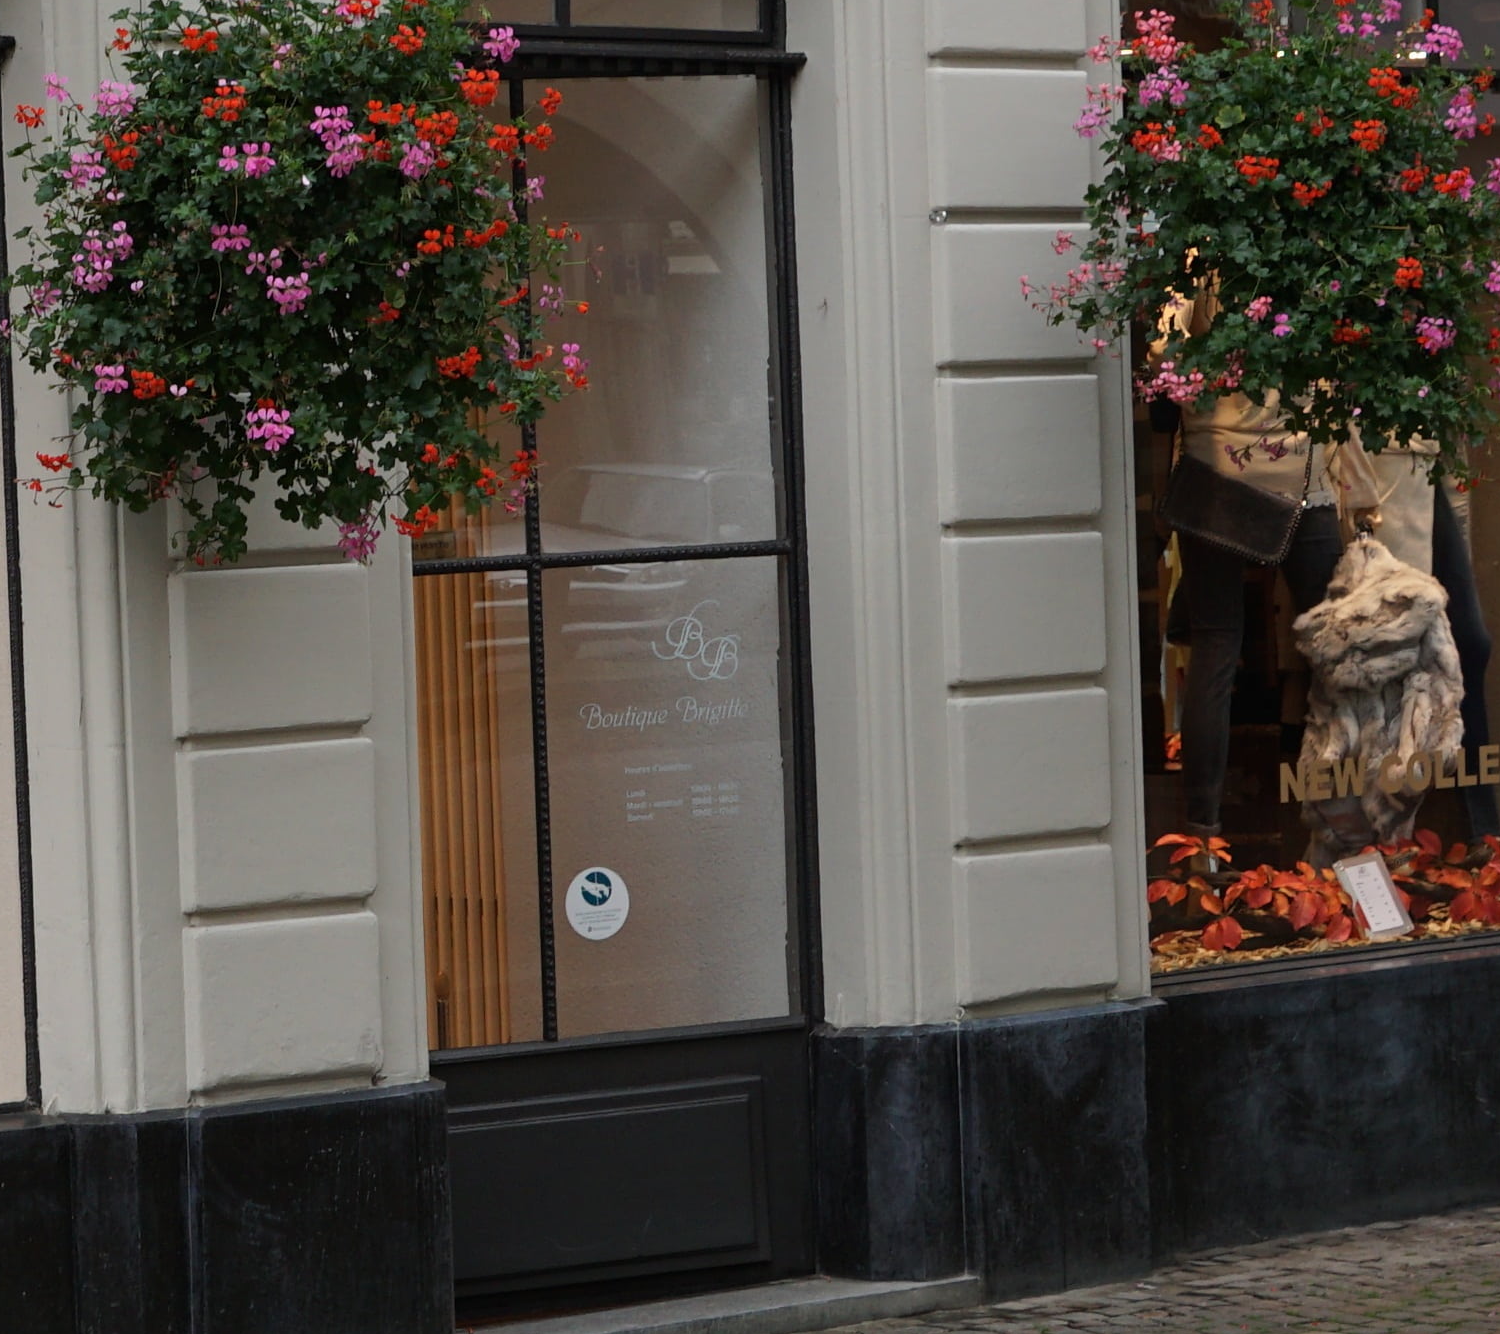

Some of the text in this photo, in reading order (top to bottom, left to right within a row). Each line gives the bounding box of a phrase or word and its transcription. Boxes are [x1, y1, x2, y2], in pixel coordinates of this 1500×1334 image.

[580, 696, 748, 732] Boutique Brigitte
[1279, 759, 1367, 804] NEW
